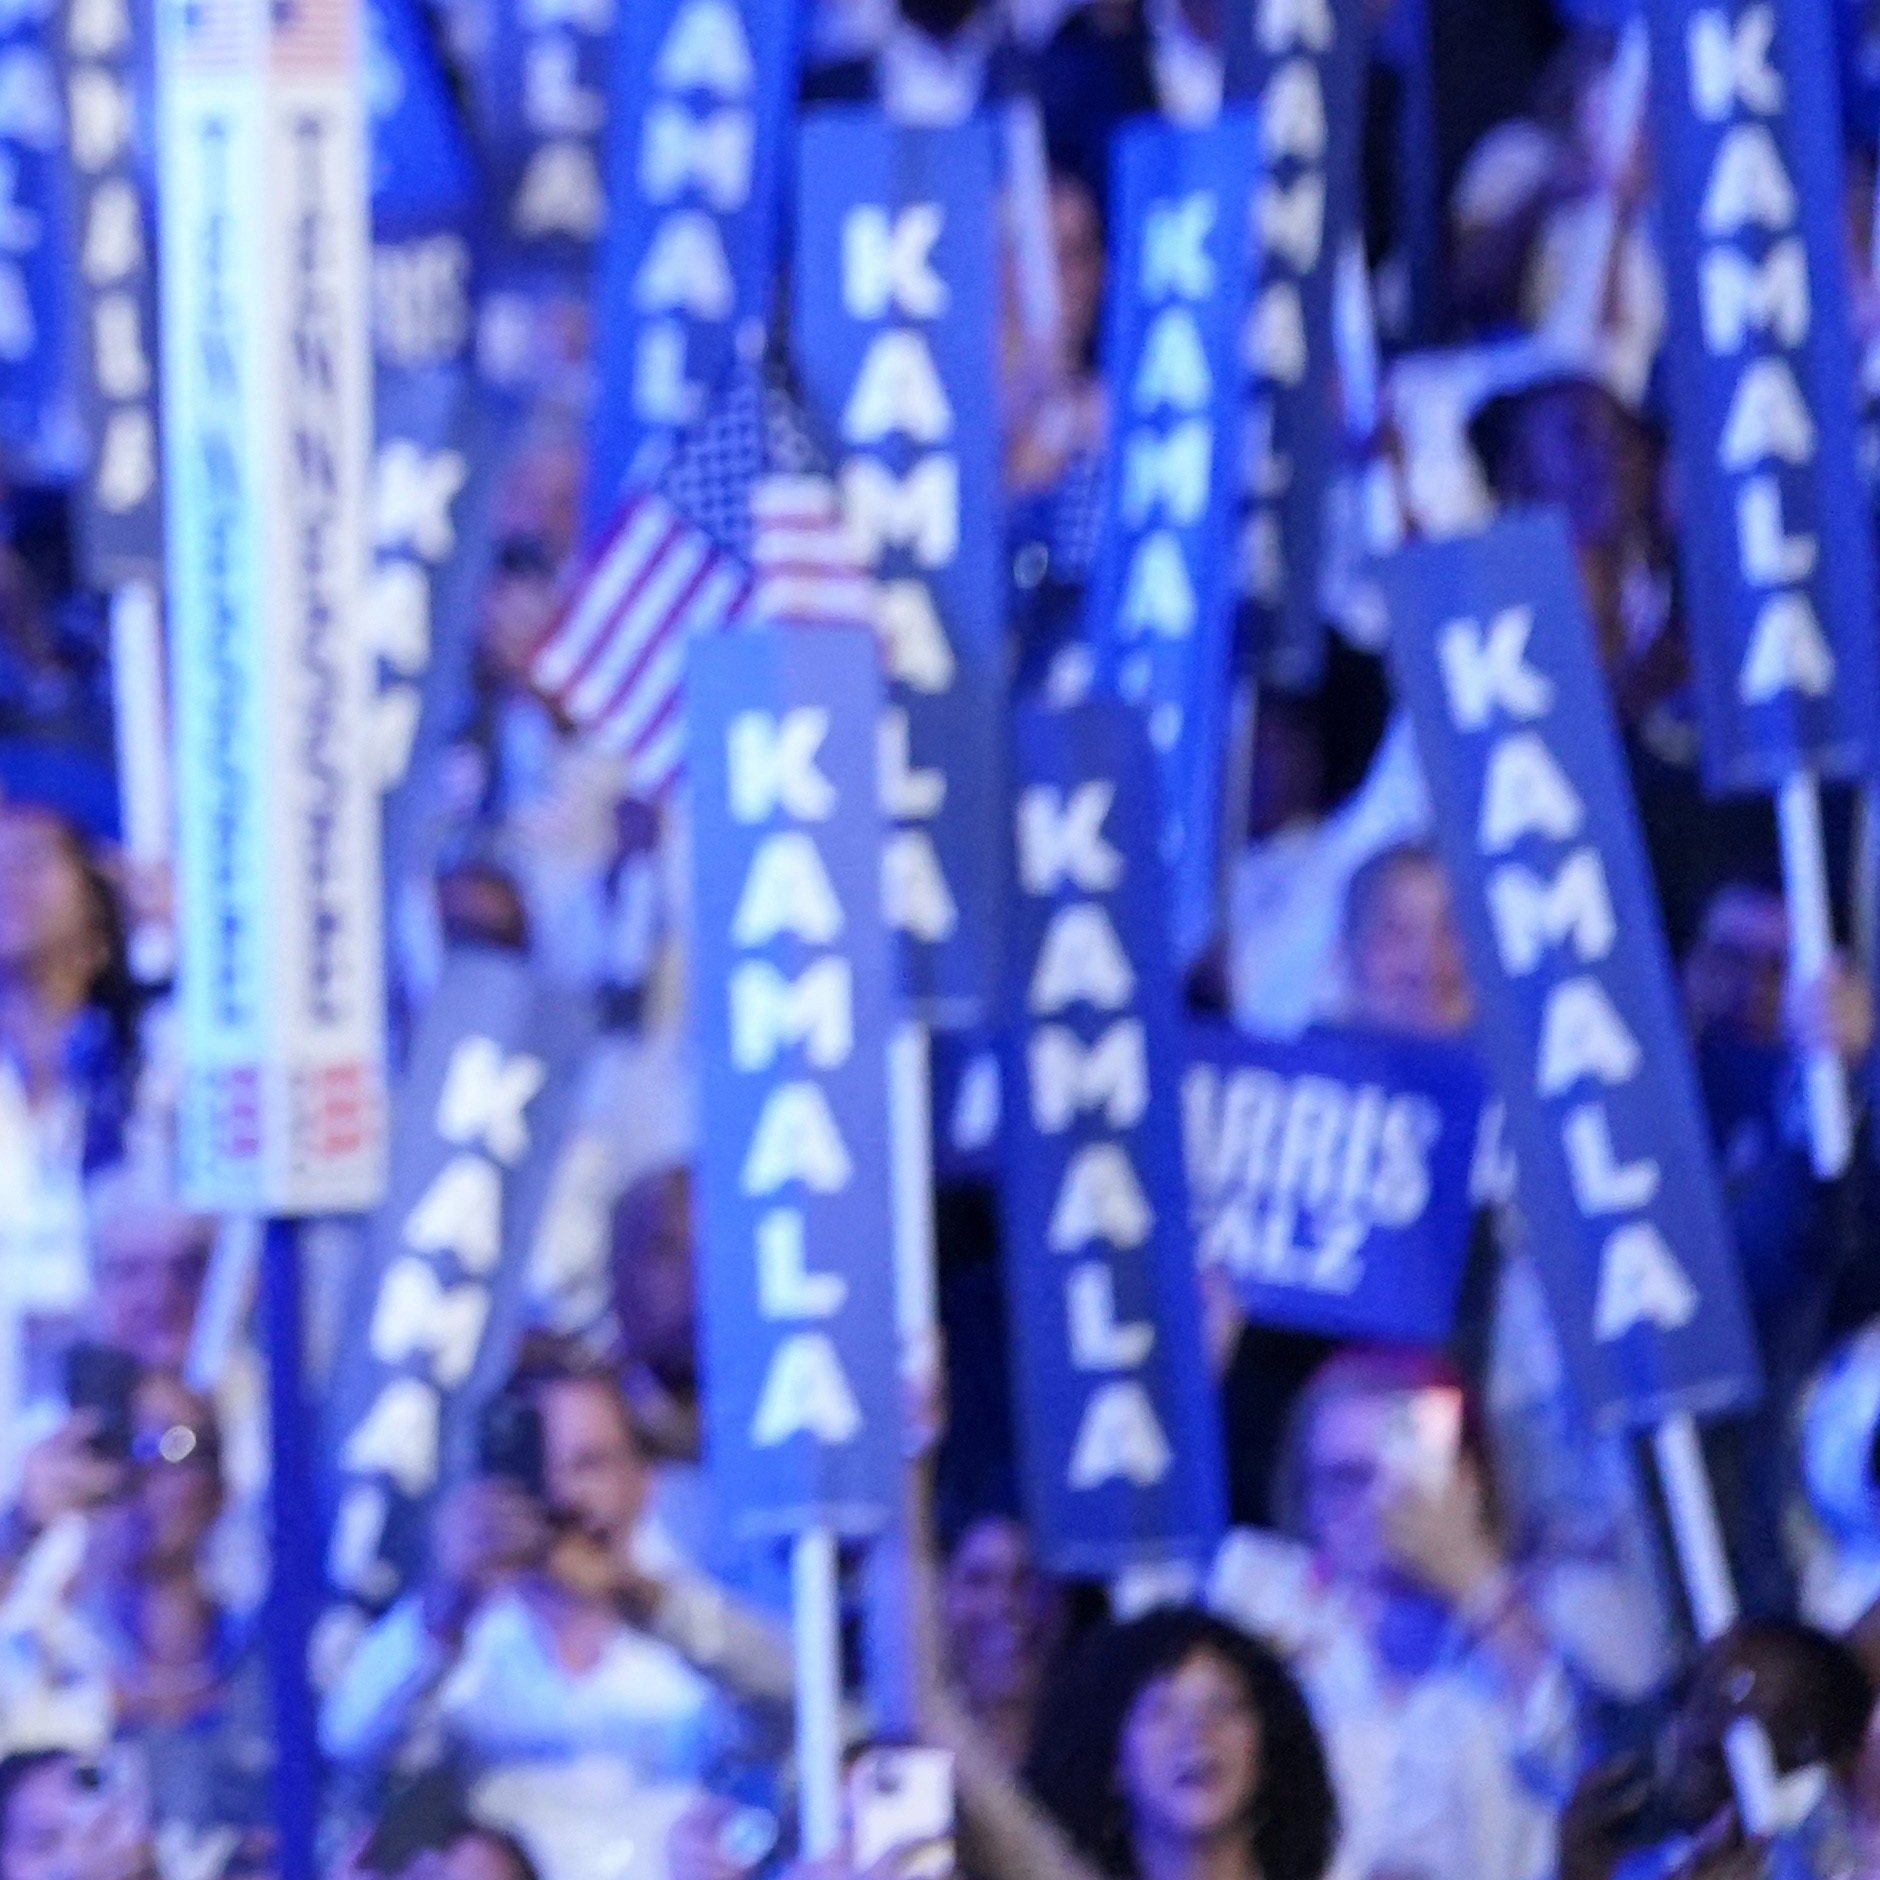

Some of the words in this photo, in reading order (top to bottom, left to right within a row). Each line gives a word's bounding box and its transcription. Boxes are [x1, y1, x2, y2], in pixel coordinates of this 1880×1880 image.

[843, 203, 960, 940] KAMALA
[1688, 5, 1837, 700] KAMALA
[726, 708, 862, 1445] KAMALA
[1017, 780, 1174, 1488] KAMALA
[1440, 608, 1698, 1338] KAMALA
